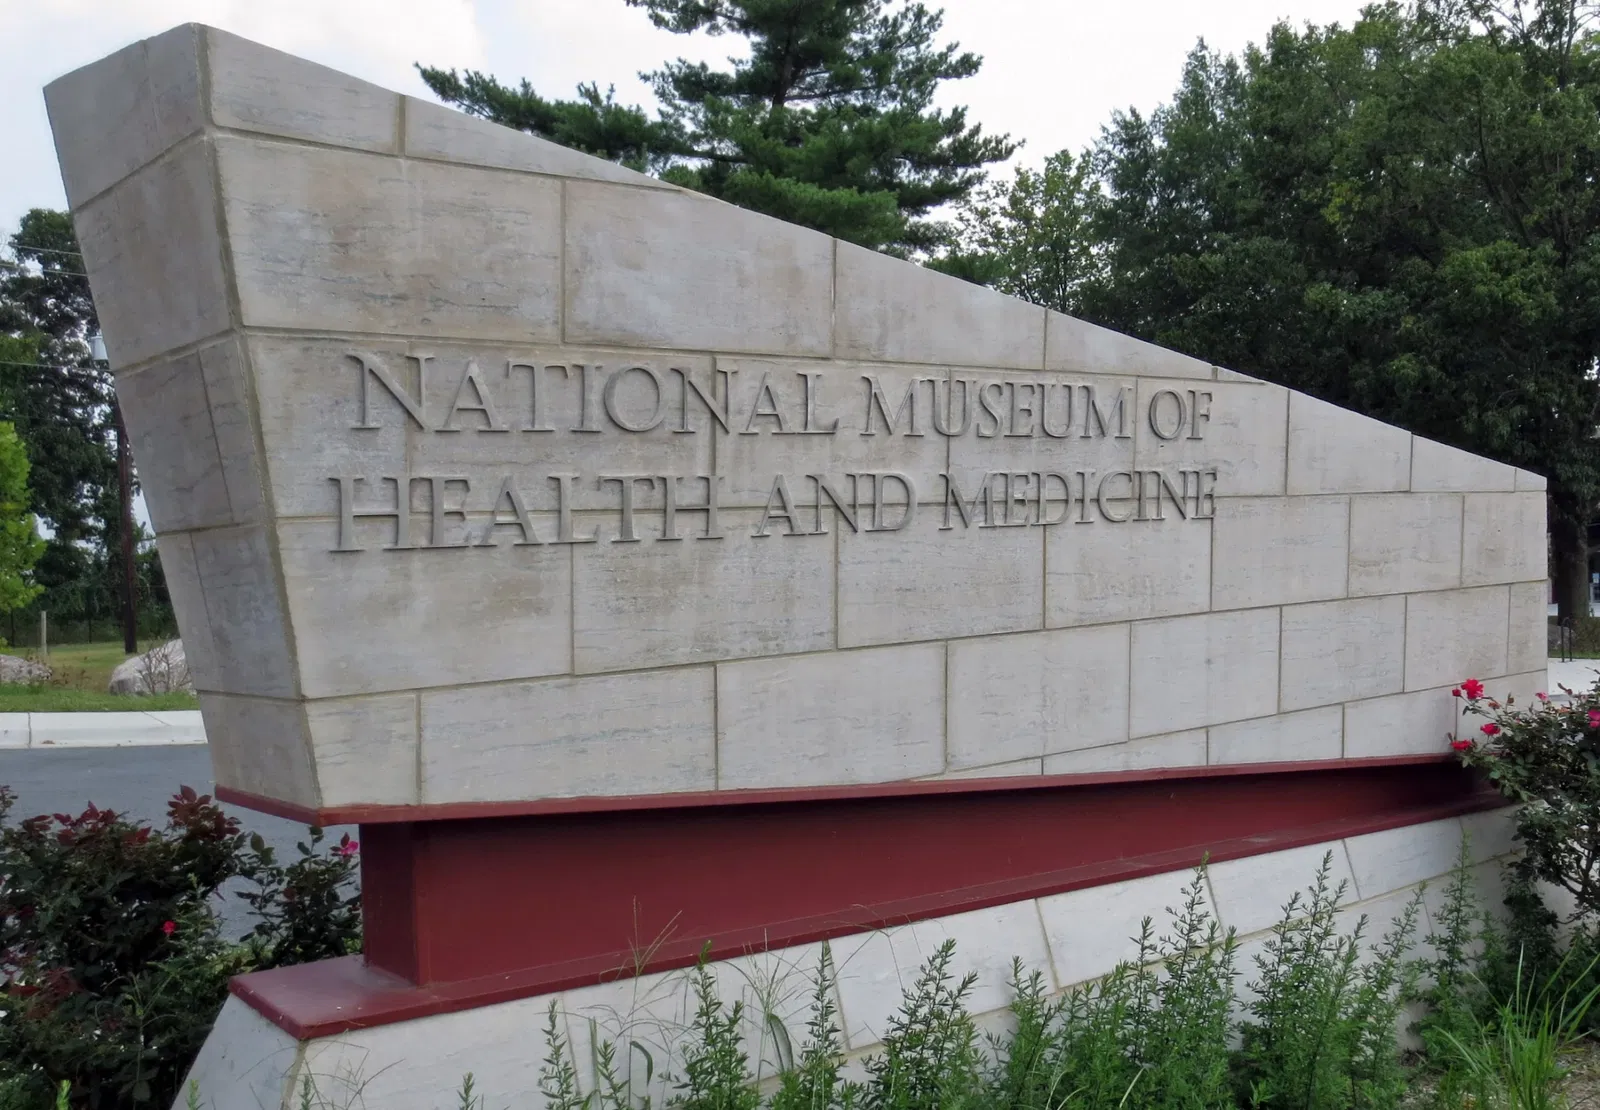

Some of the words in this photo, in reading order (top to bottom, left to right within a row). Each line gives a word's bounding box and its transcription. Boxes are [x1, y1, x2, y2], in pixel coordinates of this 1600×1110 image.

[346, 351, 839, 436] NATIONAL
[860, 375, 1133, 440] MUSEUM
[1148, 387, 1213, 440] OF
[328, 474, 725, 553] HEALTH
[751, 473, 917, 538] AND
[938, 471, 1218, 531] MEDICINE
